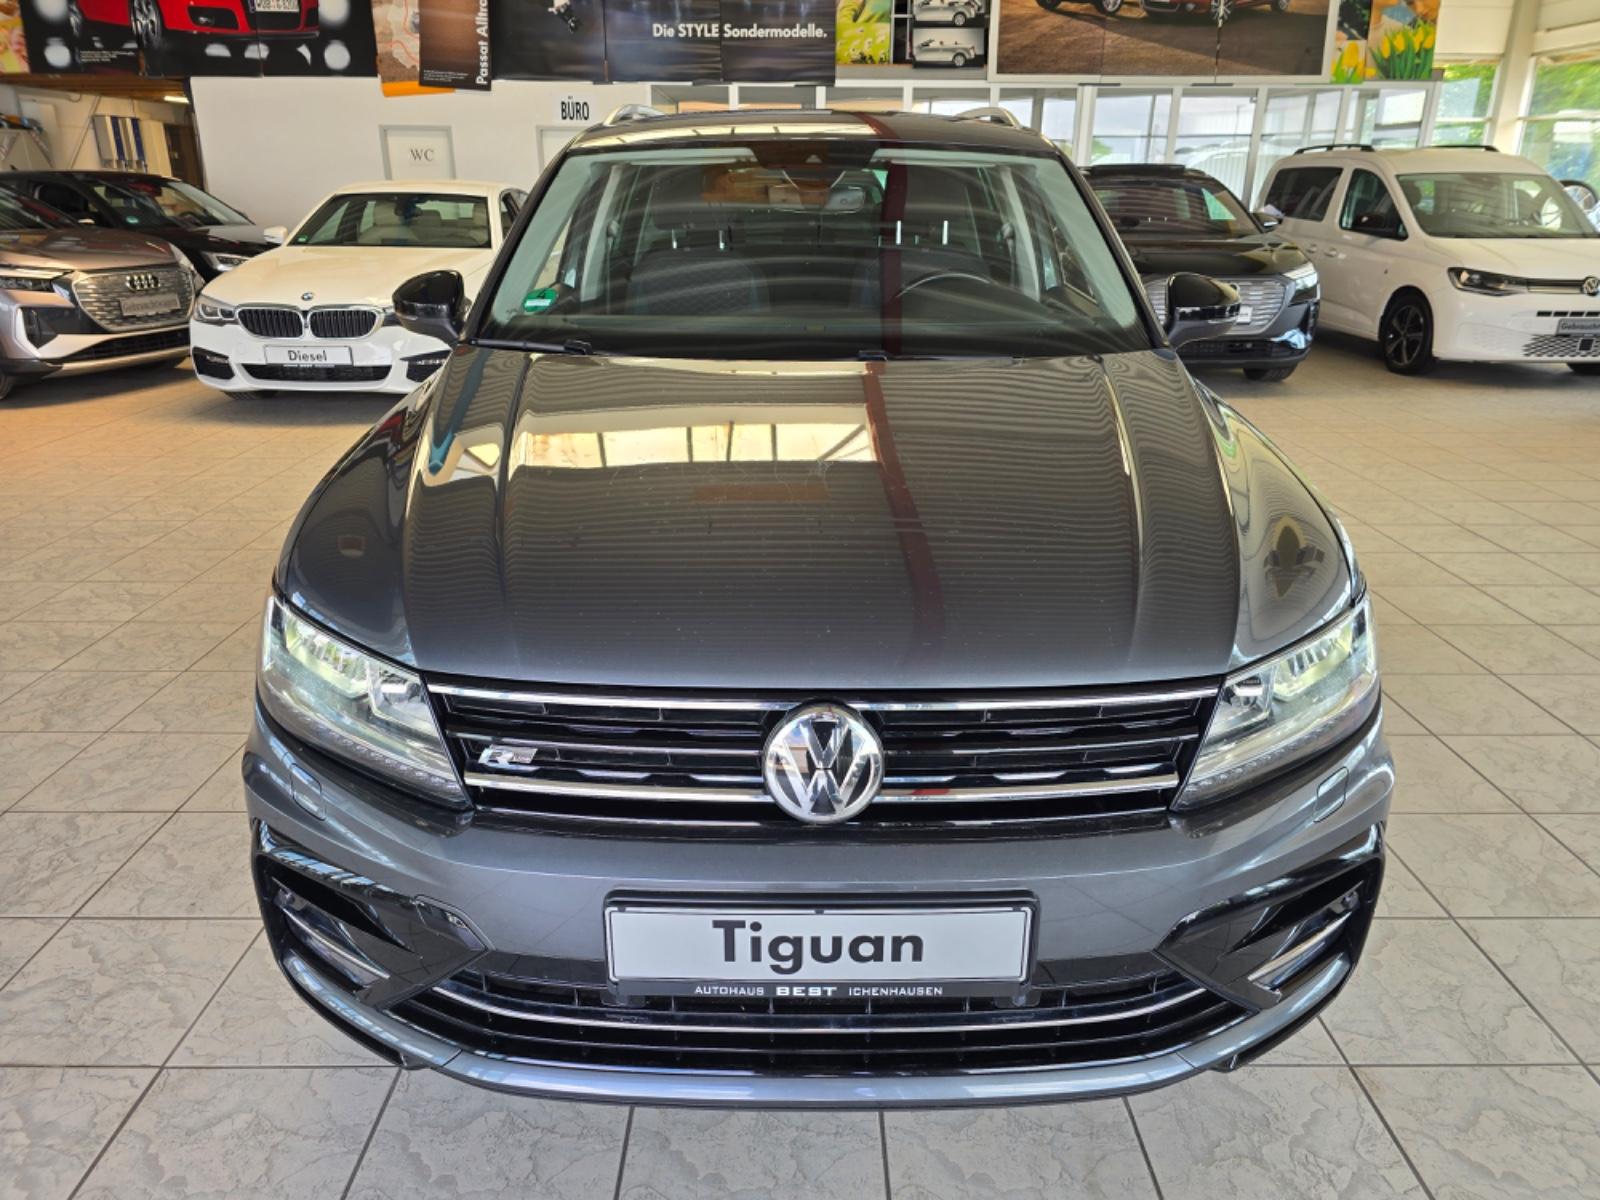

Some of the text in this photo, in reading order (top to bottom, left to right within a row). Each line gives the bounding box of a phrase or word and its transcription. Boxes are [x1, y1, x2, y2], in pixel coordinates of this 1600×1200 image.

[652, 23, 828, 38] Die STYLE Sondermodelle.
[475, 40, 489, 85] Passat
[560, 95, 590, 121] BÜRO
[410, 148, 434, 162] WC
[287, 349, 328, 361] Diesel
[712, 919, 924, 975] Tiguan
[694, 986, 943, 997] AUTOHAUS BEST ICHENHAUSEN
